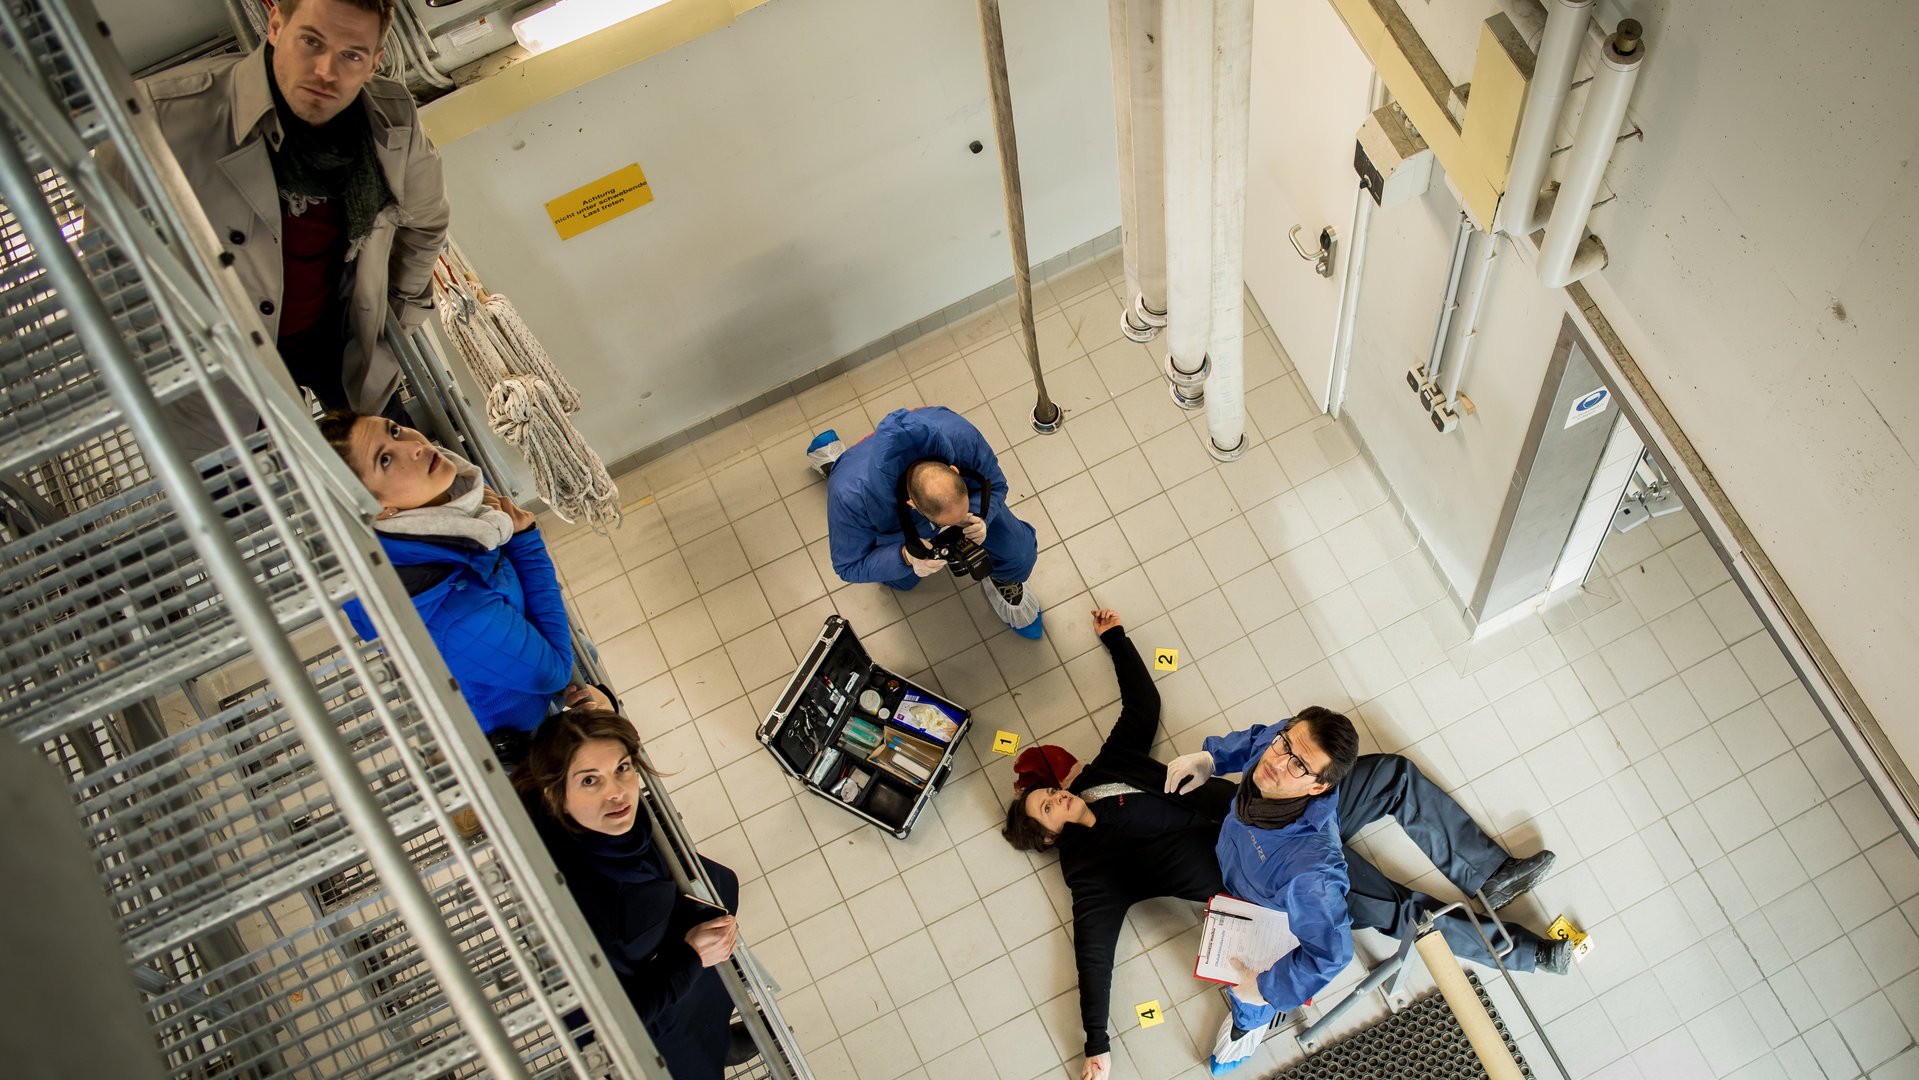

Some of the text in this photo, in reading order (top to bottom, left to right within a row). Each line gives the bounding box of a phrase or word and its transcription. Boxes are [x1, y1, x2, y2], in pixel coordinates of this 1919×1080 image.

[554, 180, 648, 224] nicht unter schwebende
[582, 188, 616, 206] Achtung
[582, 197, 625, 219] Last treten
[1158, 654, 1173, 665] 2
[1557, 928, 1570, 940] 3
[1579, 943, 1588, 955] 3
[1140, 1008, 1156, 1019] 4
